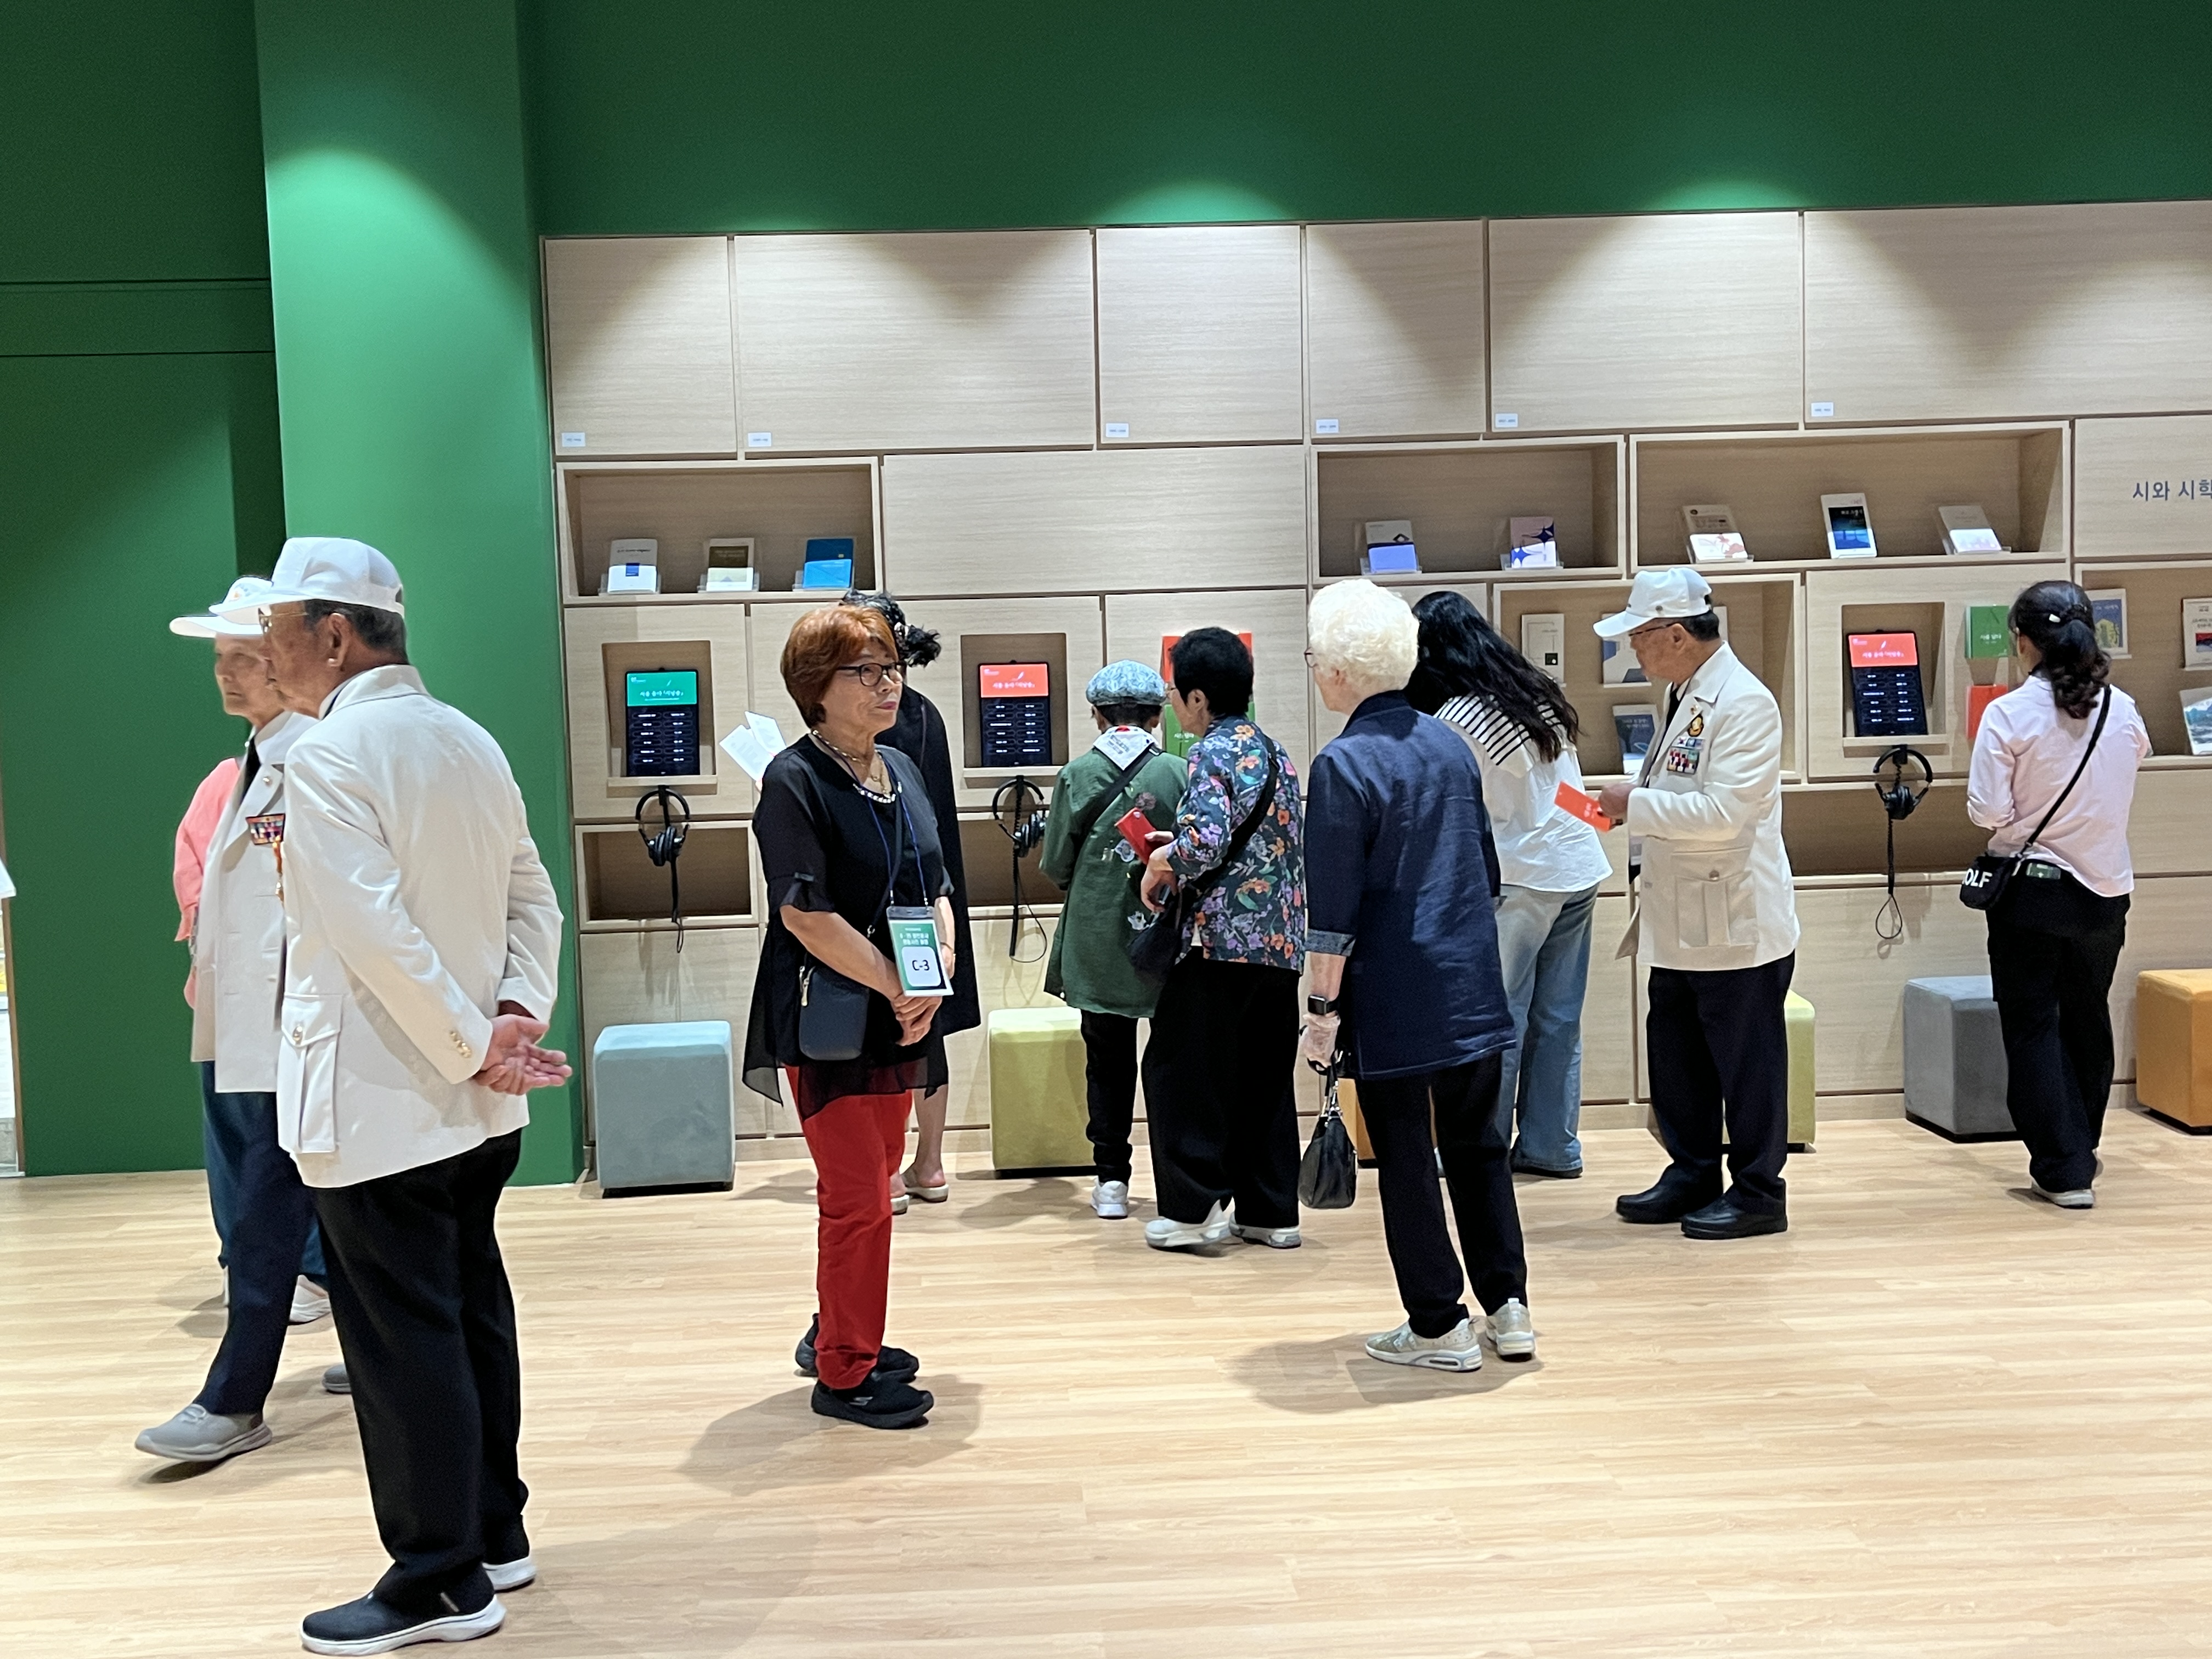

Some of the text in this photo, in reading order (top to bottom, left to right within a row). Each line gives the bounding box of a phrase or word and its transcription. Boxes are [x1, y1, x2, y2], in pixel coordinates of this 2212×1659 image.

[2132, 480, 2171, 501] 시와
[1962, 868, 1993, 888] OLF
[912, 959, 930, 971] C-3
